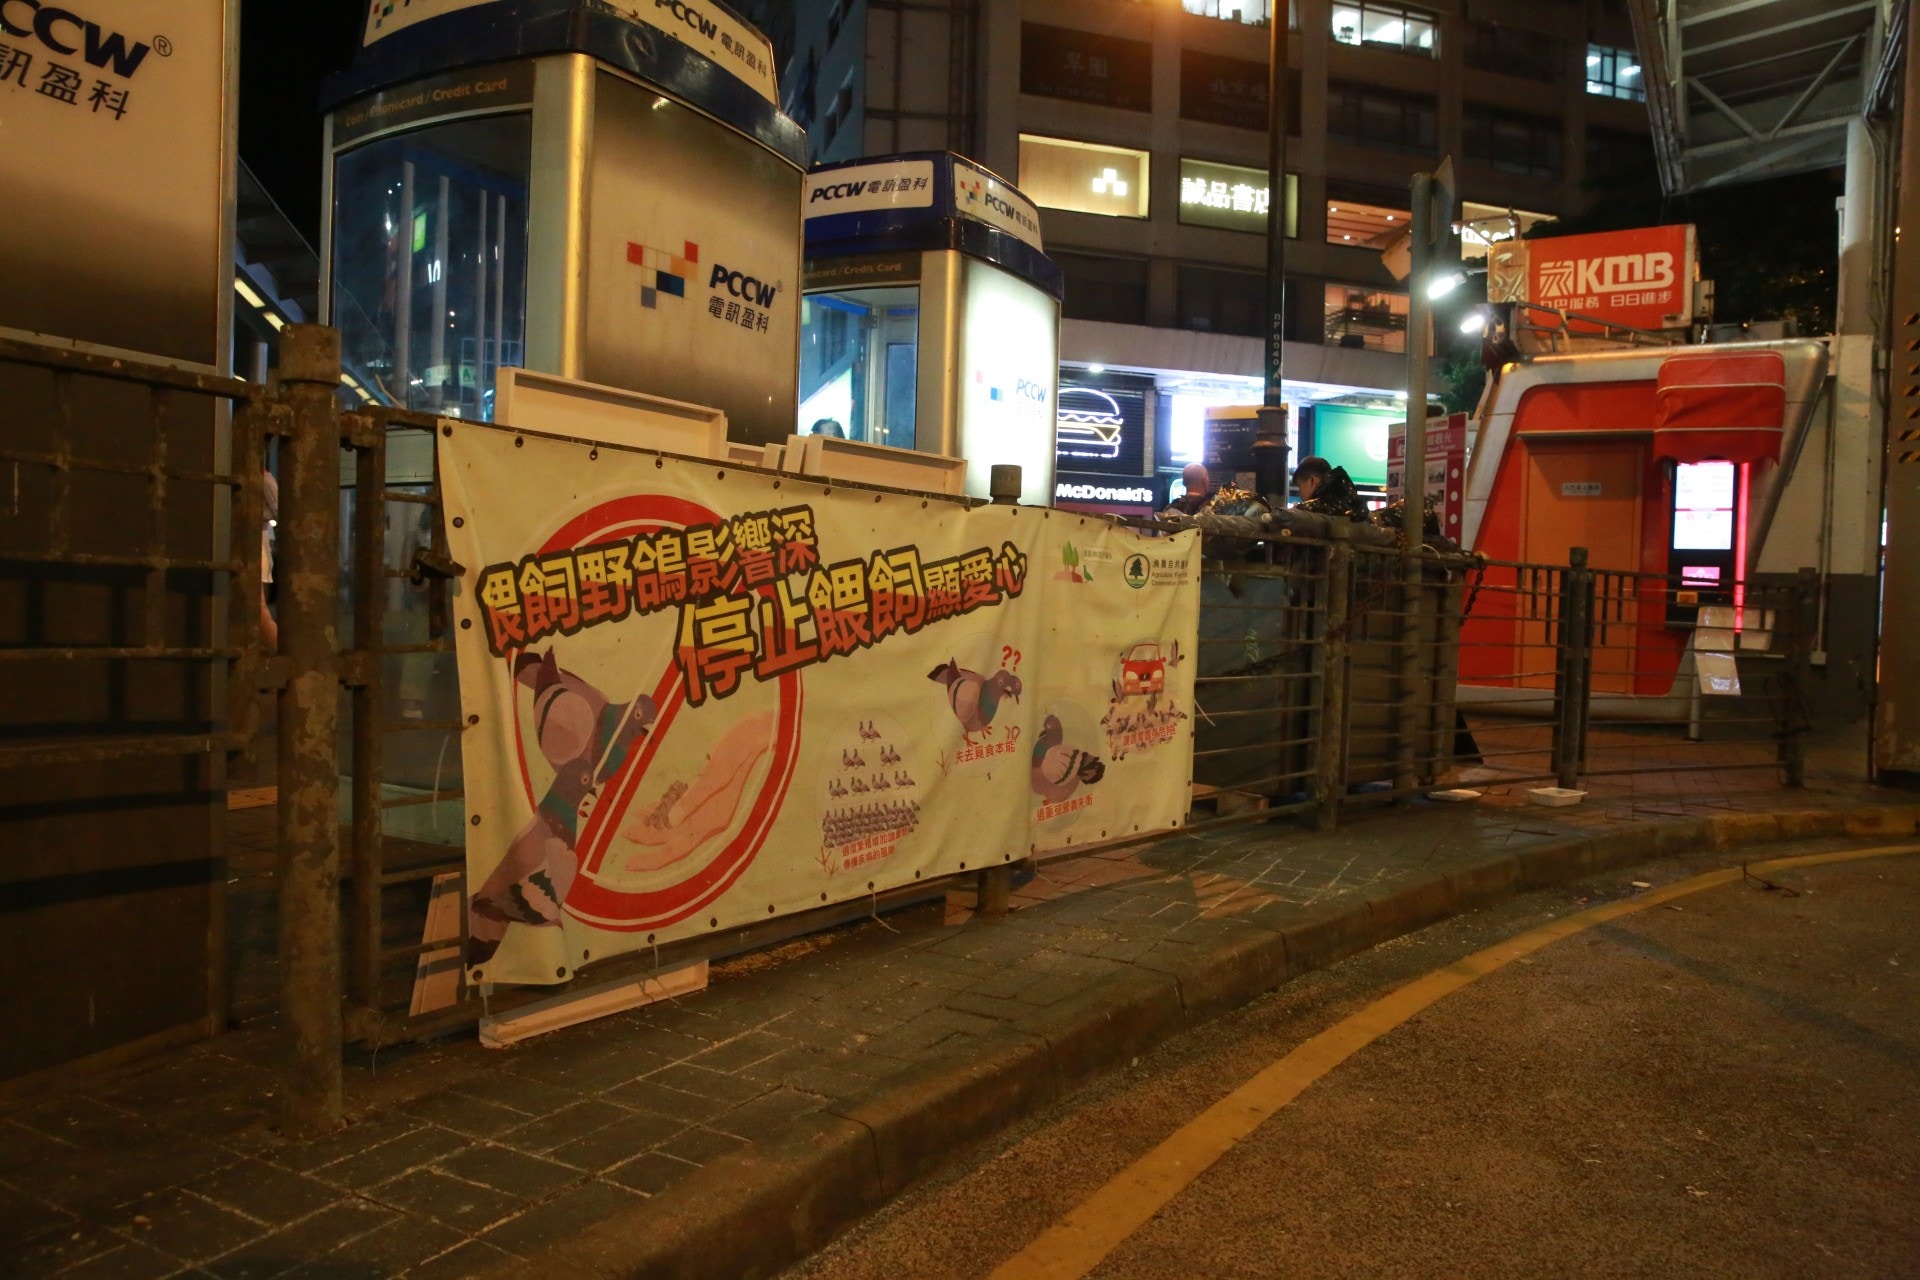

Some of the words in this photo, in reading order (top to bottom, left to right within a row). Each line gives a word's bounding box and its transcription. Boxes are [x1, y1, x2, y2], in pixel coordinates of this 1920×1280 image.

[370, 93, 424, 118] Phonecard
[432, 84, 470, 101] Credit
[475, 78, 507, 93] Card
[810, 180, 866, 203] PCCW
[867, 177, 929, 193] 電訊盈科
[984, 191, 1015, 220] PCCW
[877, 262, 902, 272] Card
[709, 263, 777, 309] PCCW
[1610, 290, 1672, 308] 日日進步
[708, 295, 769, 334] 電訊盈科
[1016, 378, 1047, 403] PCCW
[1056, 483, 1153, 502] McDonald's
[955, 740, 1016, 764] 失去覓食本能
